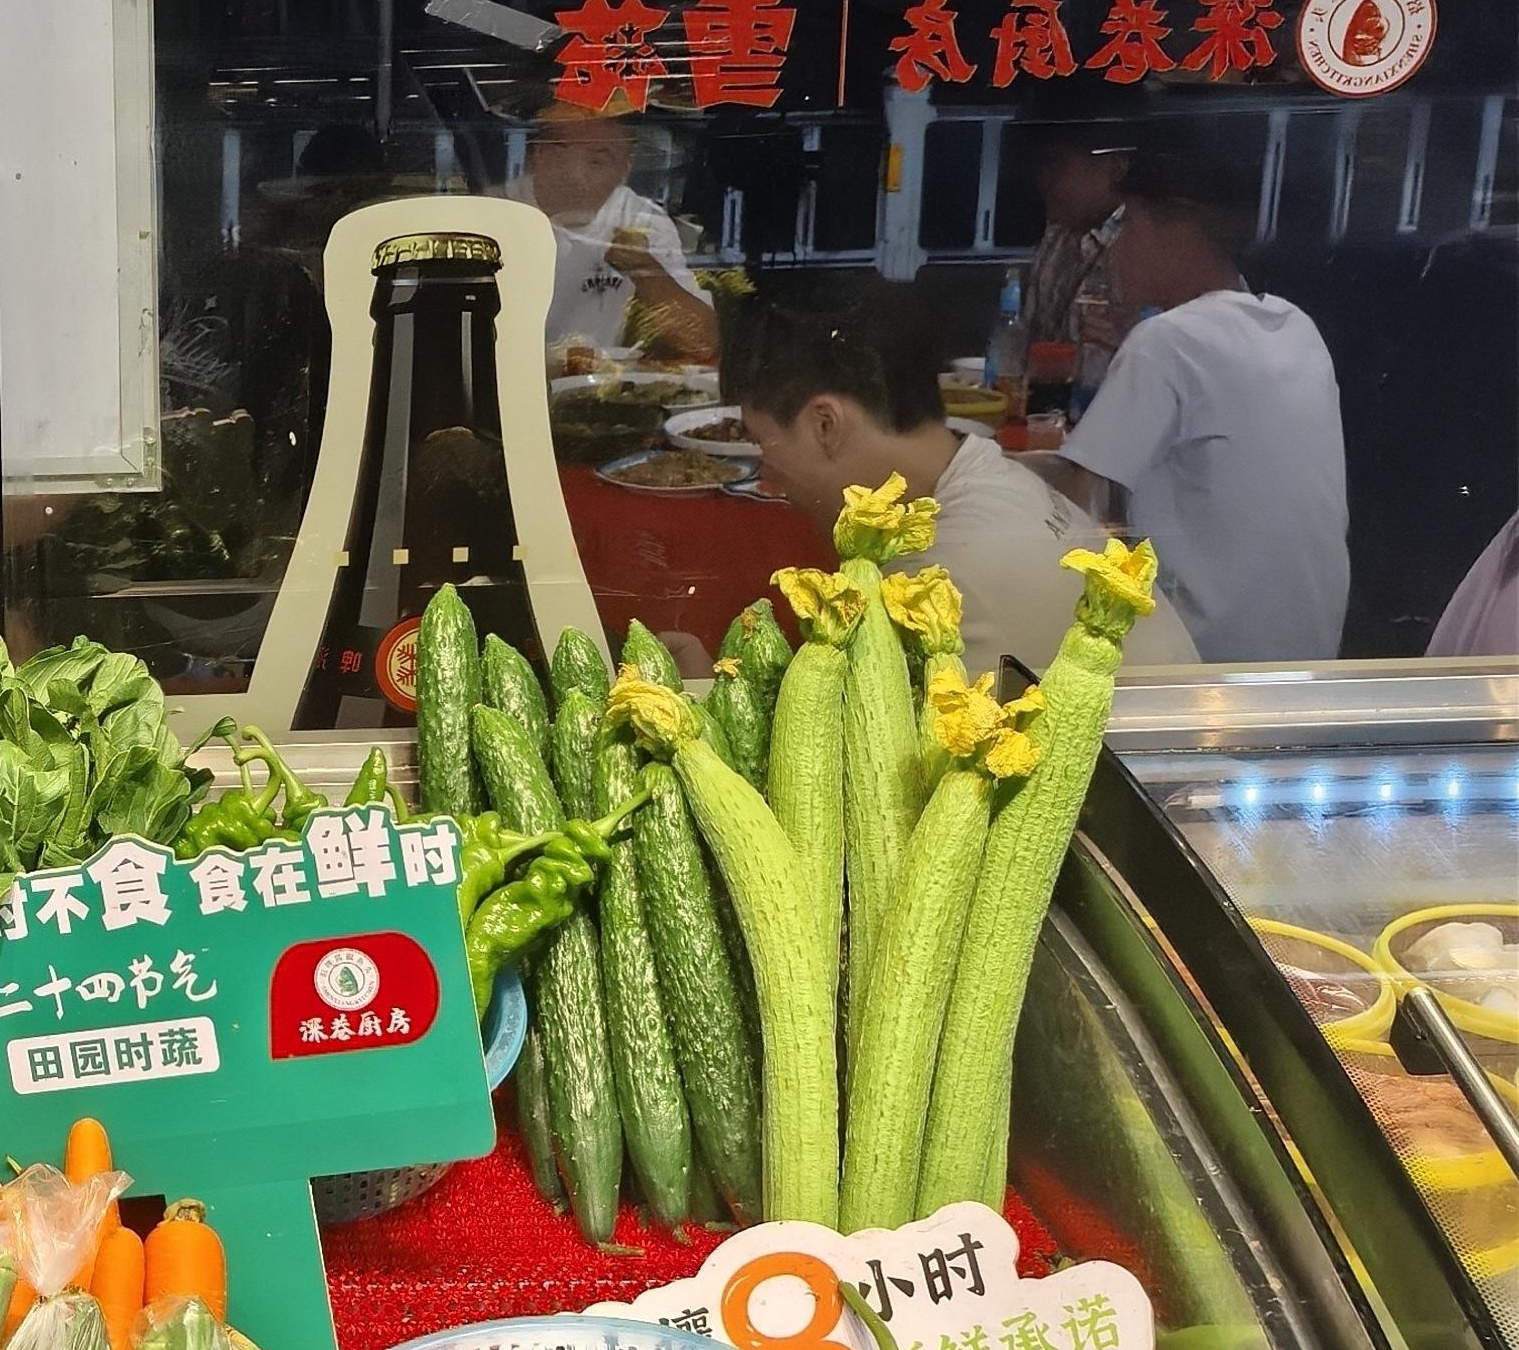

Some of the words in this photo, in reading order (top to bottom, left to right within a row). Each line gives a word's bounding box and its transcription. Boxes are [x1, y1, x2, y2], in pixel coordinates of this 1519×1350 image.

[188, 806, 459, 917] 食在鲜时
[28, 1025, 204, 1083] 田园时蔬
[298, 1006, 412, 1044] 深巷厨房
